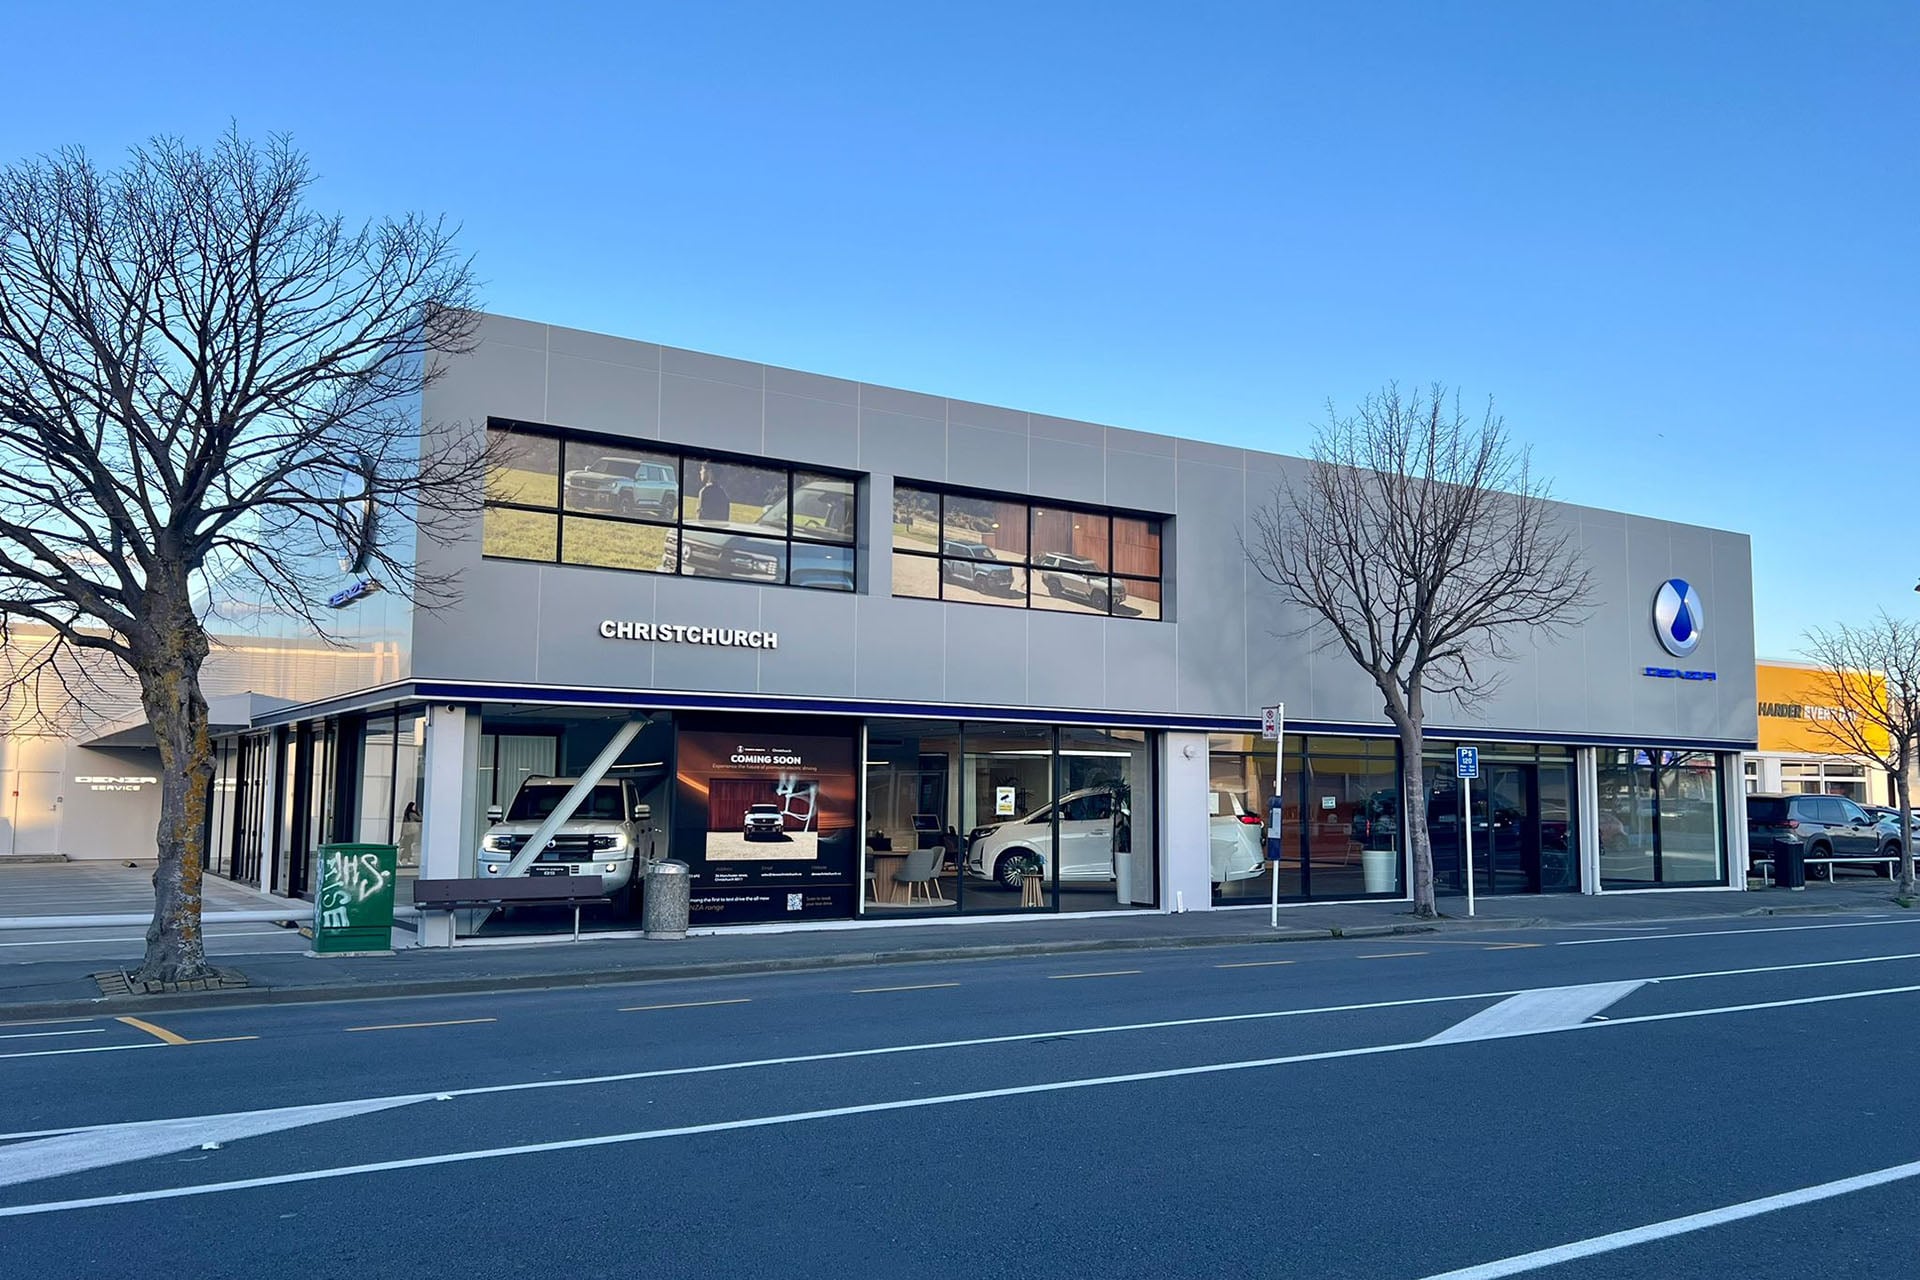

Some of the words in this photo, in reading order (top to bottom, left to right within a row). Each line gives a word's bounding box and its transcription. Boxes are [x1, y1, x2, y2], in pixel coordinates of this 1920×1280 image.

[600, 620, 778, 649] CHRISTCHURCH
[1758, 702, 1801, 719] HARDER
[730, 754, 772, 764] COMING
[773, 756, 801, 765] SOON
[75, 776, 157, 784] DENZA
